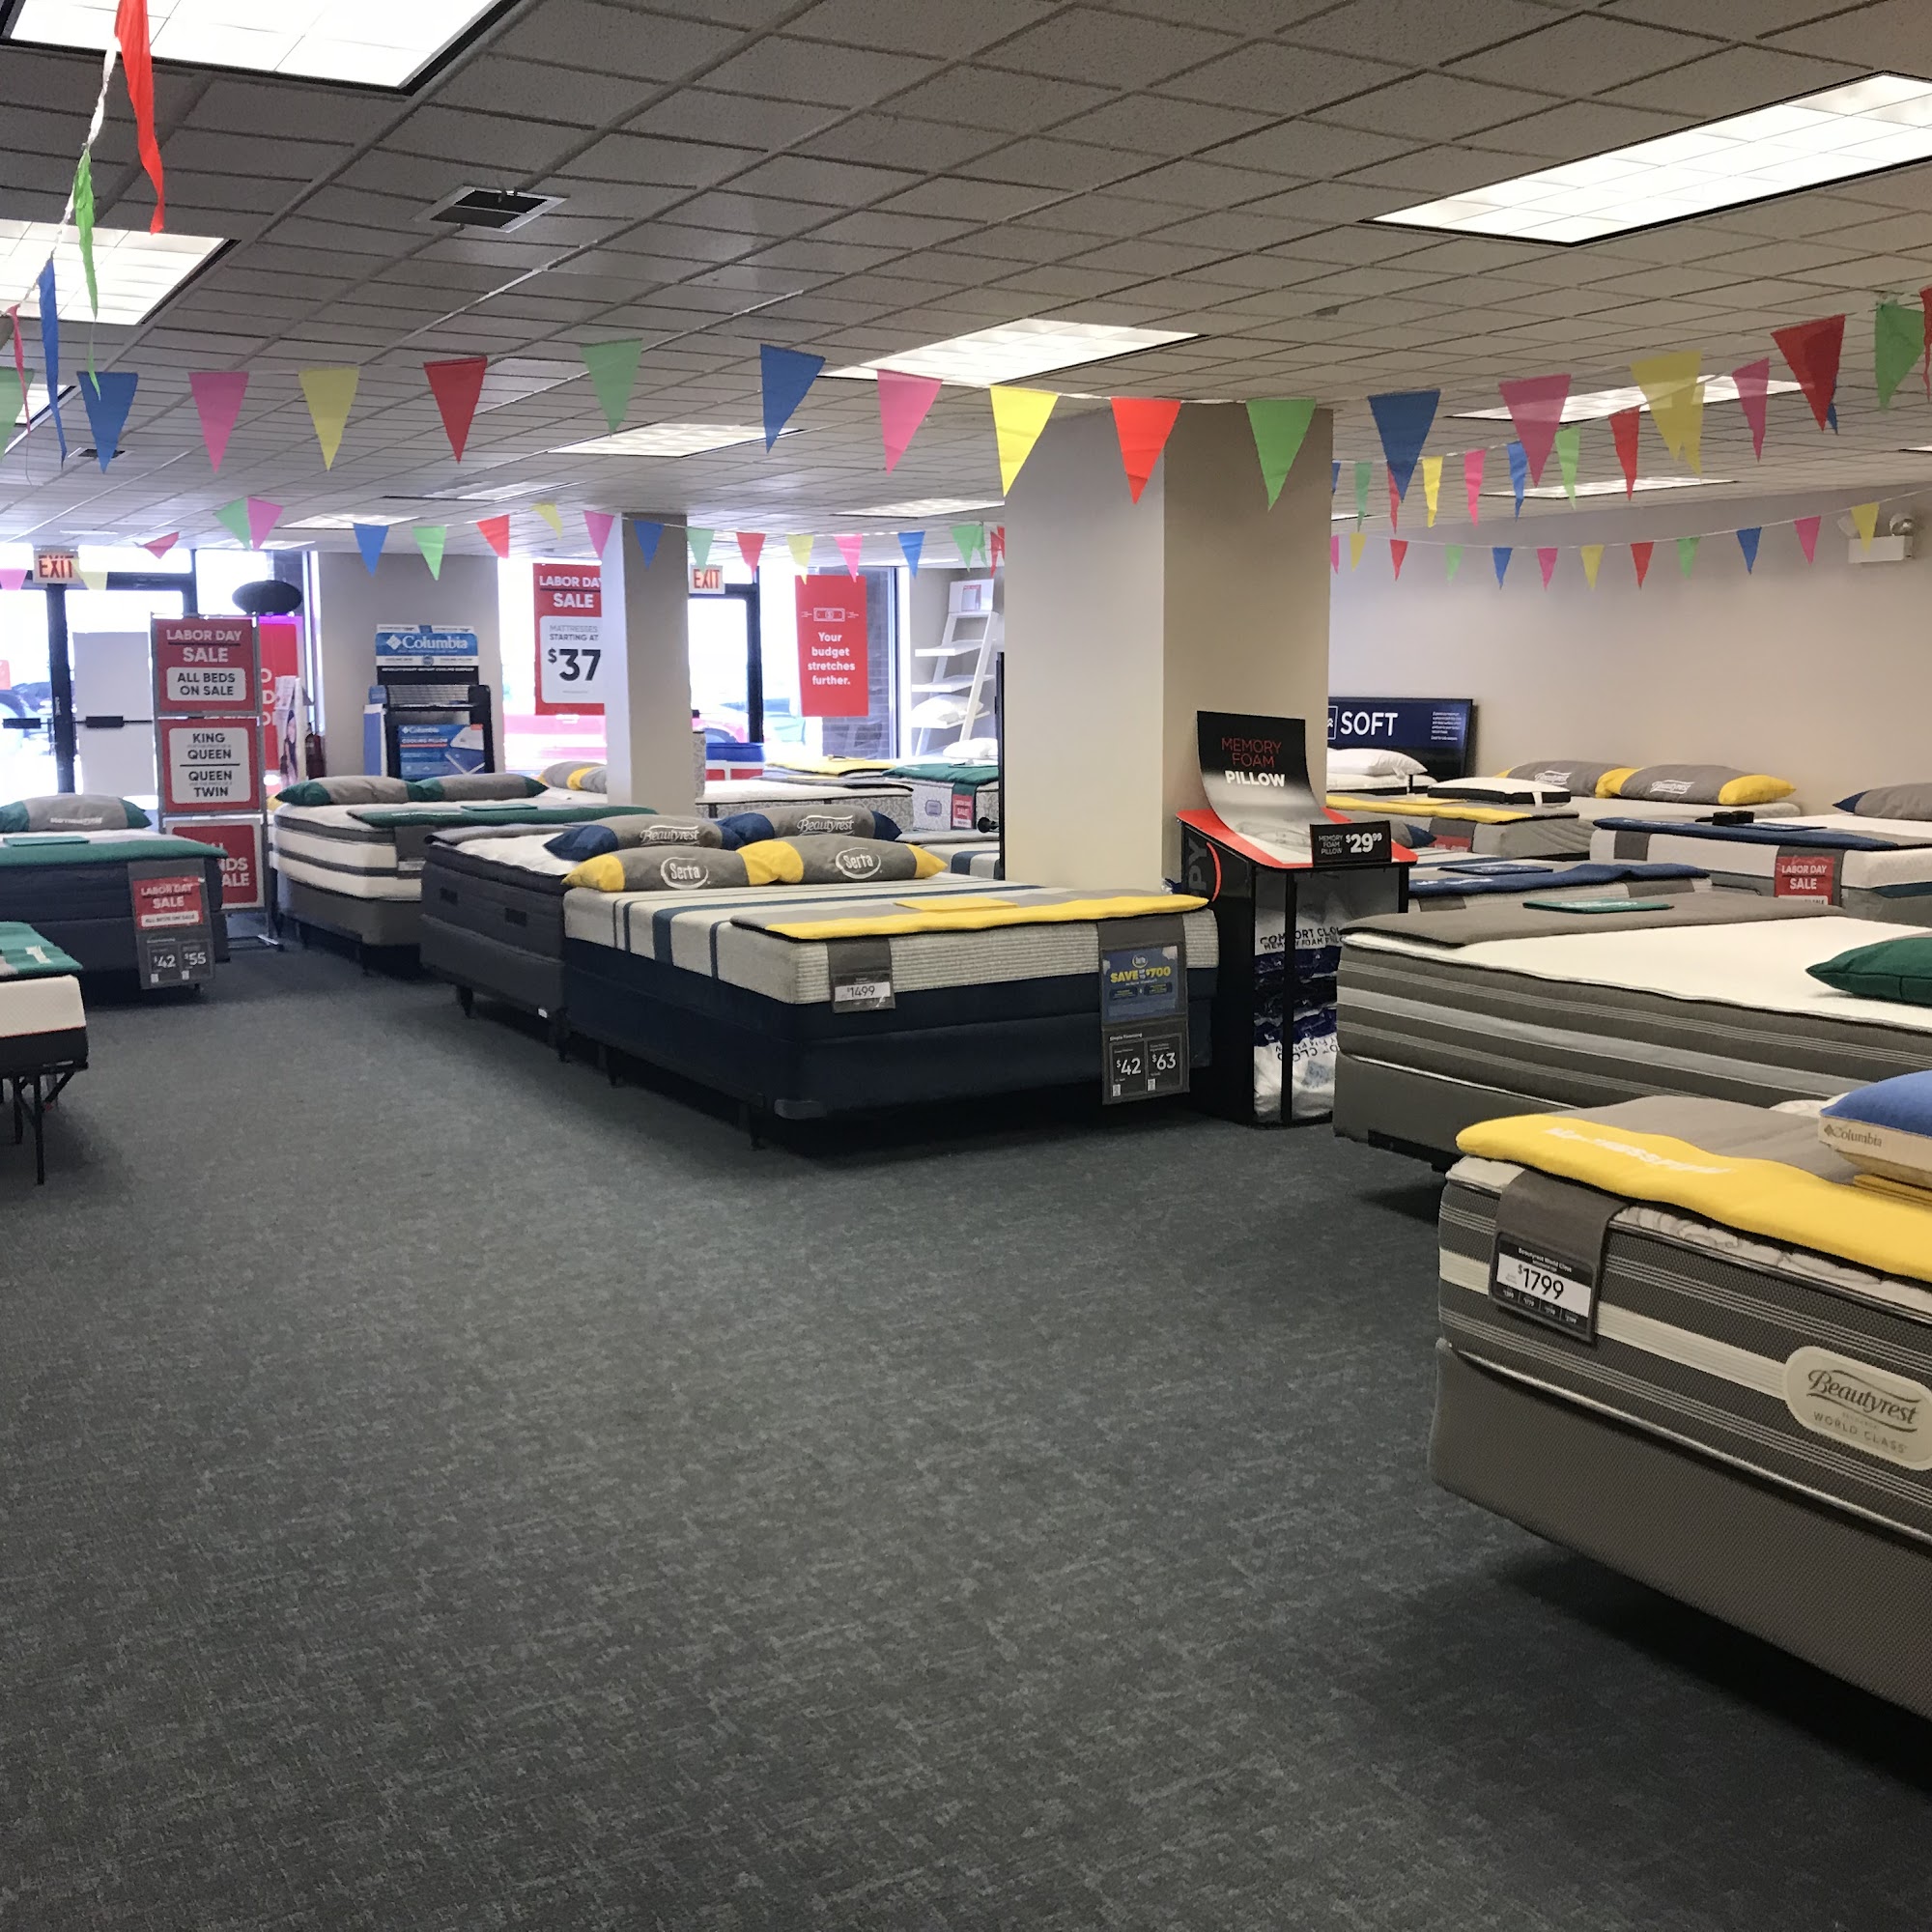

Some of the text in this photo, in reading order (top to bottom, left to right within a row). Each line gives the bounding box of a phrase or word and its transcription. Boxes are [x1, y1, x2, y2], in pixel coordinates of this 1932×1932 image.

[39, 554, 74, 579] EXIT
[539, 575, 581, 587] LABOR
[693, 568, 720, 589] EXIT
[553, 592, 595, 609] SALE
[166, 629, 242, 641] LABOR DAY
[549, 624, 598, 633] MATTRESSES
[402, 635, 469, 649] Columbia
[818, 632, 842, 642] Your
[183, 646, 230, 663] SALE
[811, 646, 850, 659] budget
[547, 647, 602, 681] $37
[808, 661, 856, 671] stretches
[177, 672, 236, 683] ALL BEDS
[812, 675, 851, 686] further.
[180, 685, 234, 696] ON SALE
[1340, 711, 1399, 736] SOFT
[192, 732, 226, 744] KING
[1221, 737, 1282, 754] MEMORY
[187, 749, 232, 760] QUEEN
[1232, 753, 1275, 768] FOAM
[188, 770, 233, 781] QUEEN
[1224, 770, 1286, 787] PILLOW
[194, 786, 229, 798] TWIN
[796, 817, 854, 833] Beautyrest
[639, 828, 700, 844] Beautyrest
[843, 853, 874, 869] Serta
[668, 862, 701, 880] Serta
[1781, 865, 1828, 874] LABOR DAY
[221, 872, 250, 888] ALE
[1789, 877, 1817, 890] SALE
[141, 883, 193, 896] LABOR DAY
[152, 895, 185, 909] SALE
[1260, 928, 1315, 945] COMORT
[185, 952, 207, 966] $55
[1110, 970, 1139, 983] SAVE
[1146, 966, 1172, 978] $700
[1116, 1057, 1142, 1075] $42
[1151, 1052, 1177, 1070] $63
[1833, 1126, 1883, 1148] Columbia
[1518, 1264, 1564, 1300] $1799
[1806, 1369, 1918, 1425] Beautyrest
[1813, 1410, 1859, 1435] WORLD
[1863, 1431, 1907, 1454] CLASS
